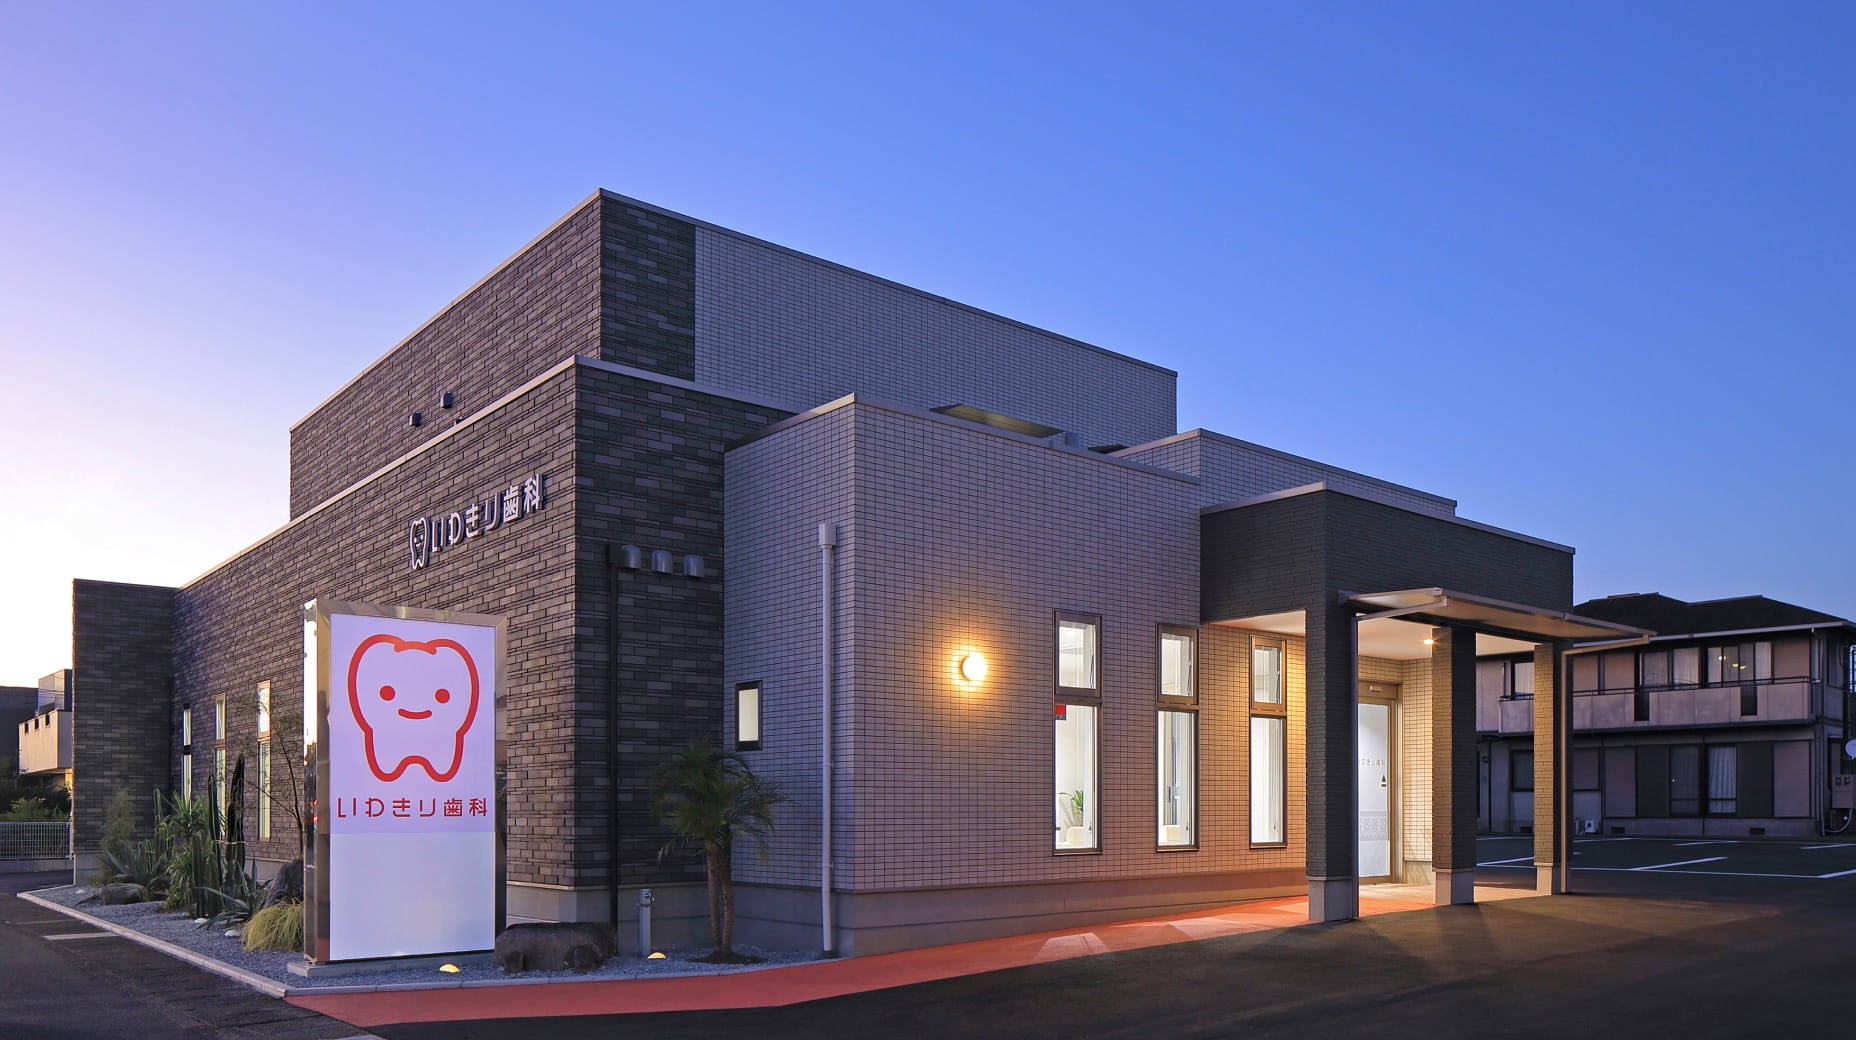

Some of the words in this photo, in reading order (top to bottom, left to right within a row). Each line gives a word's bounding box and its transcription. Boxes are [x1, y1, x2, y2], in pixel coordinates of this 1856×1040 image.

[432, 474, 542, 553] いわきり歯科
[337, 798, 488, 818] いわきり歯科
